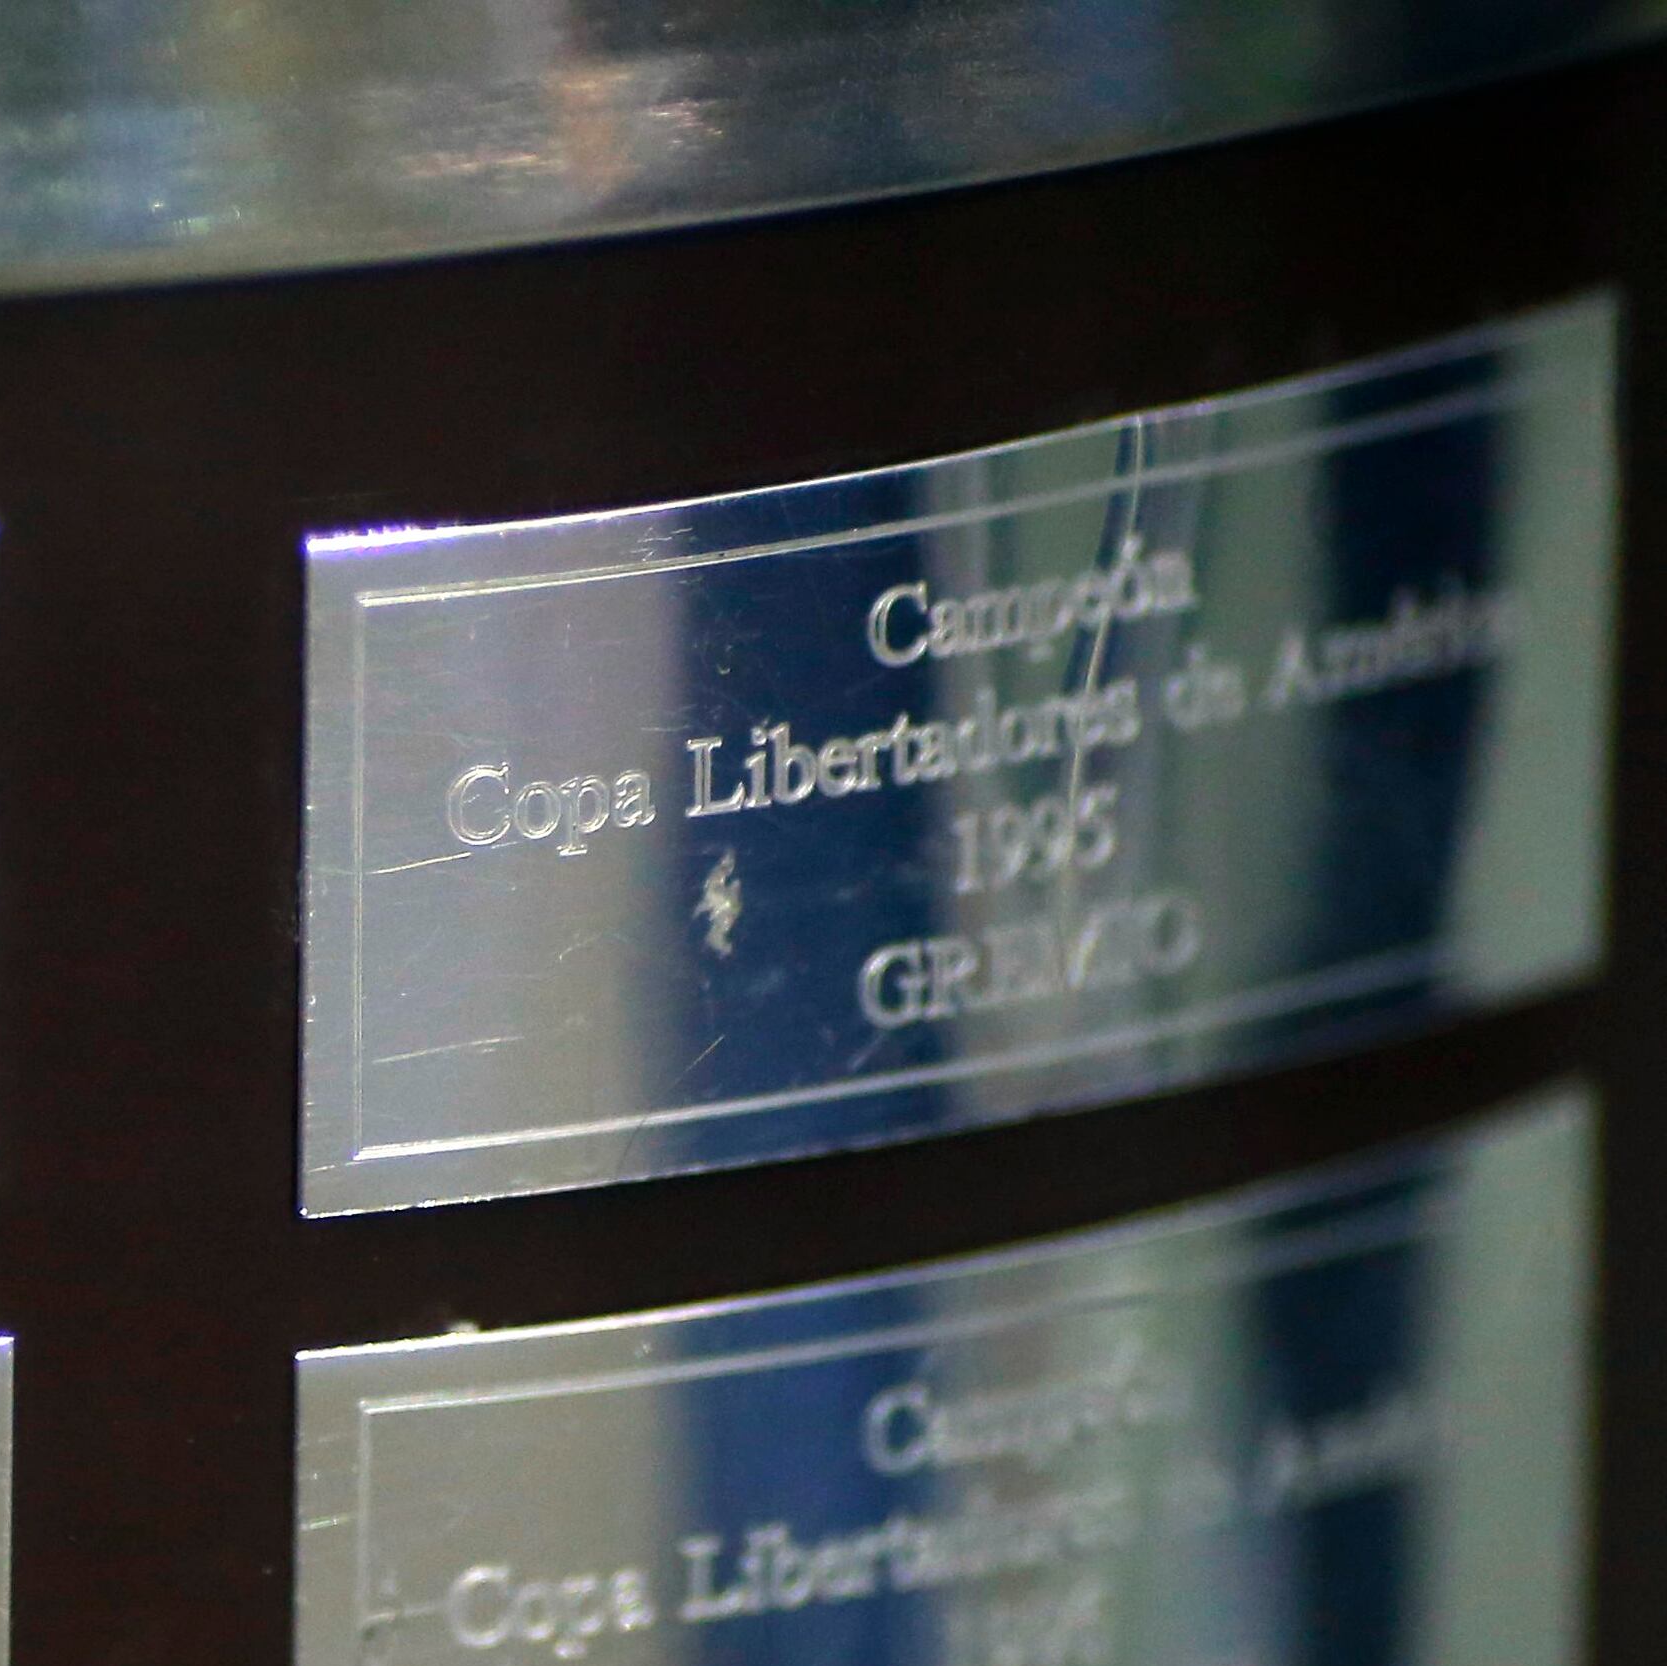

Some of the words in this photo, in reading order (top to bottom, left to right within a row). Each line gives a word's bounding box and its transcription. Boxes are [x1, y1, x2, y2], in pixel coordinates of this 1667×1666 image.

[870, 535, 1193, 666] Campeón
[447, 761, 655, 856] Copa
[685, 680, 1139, 819] Libertadores
[679, 1487, 1129, 1620] Libert
